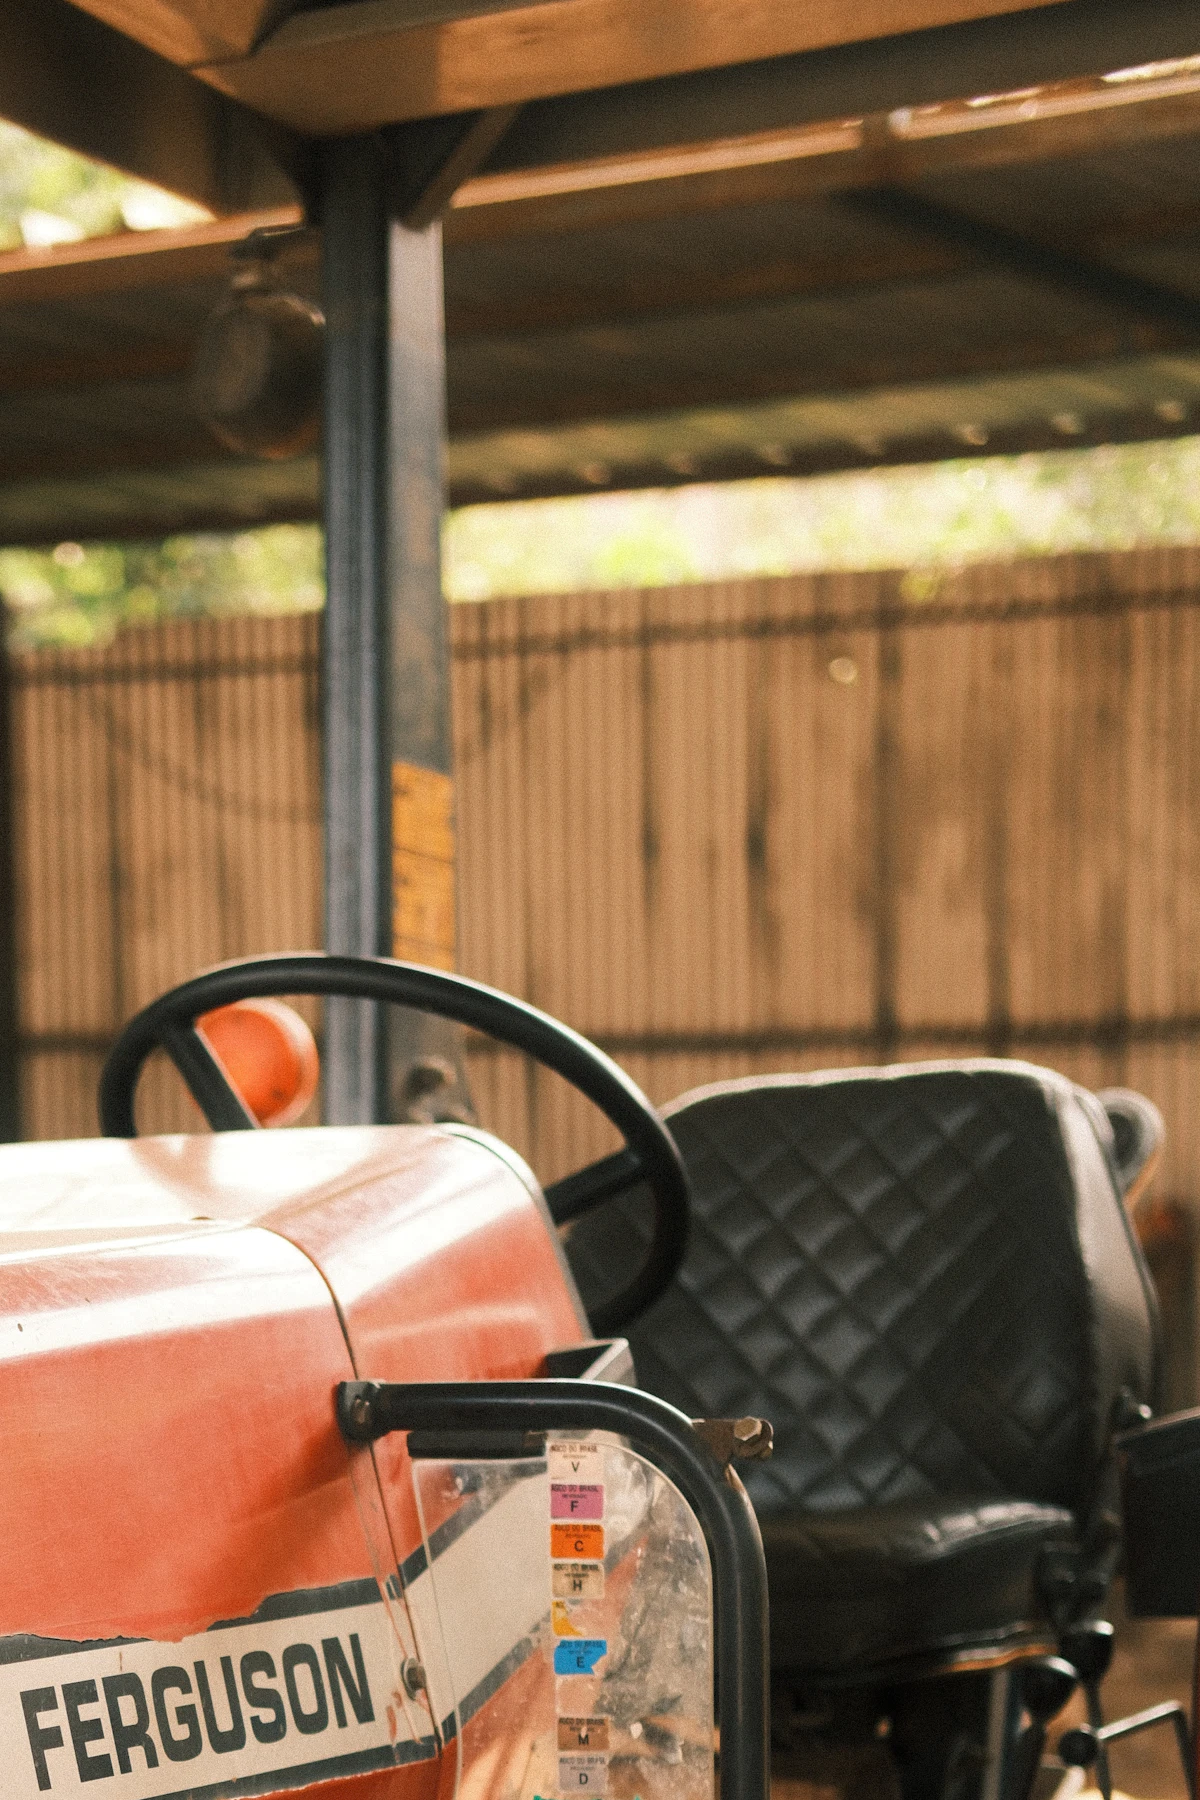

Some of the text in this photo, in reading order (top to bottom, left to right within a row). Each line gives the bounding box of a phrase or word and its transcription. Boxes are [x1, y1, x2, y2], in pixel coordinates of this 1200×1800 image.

[571, 1461, 580, 1472] V
[570, 1500, 579, 1512] F
[574, 1540, 584, 1552] C
[573, 1579, 582, 1592] H
[577, 1656, 585, 1669] E
[19, 1633, 375, 1791] FERGUSON
[578, 1733, 589, 1745] M
[579, 1773, 588, 1785] D
